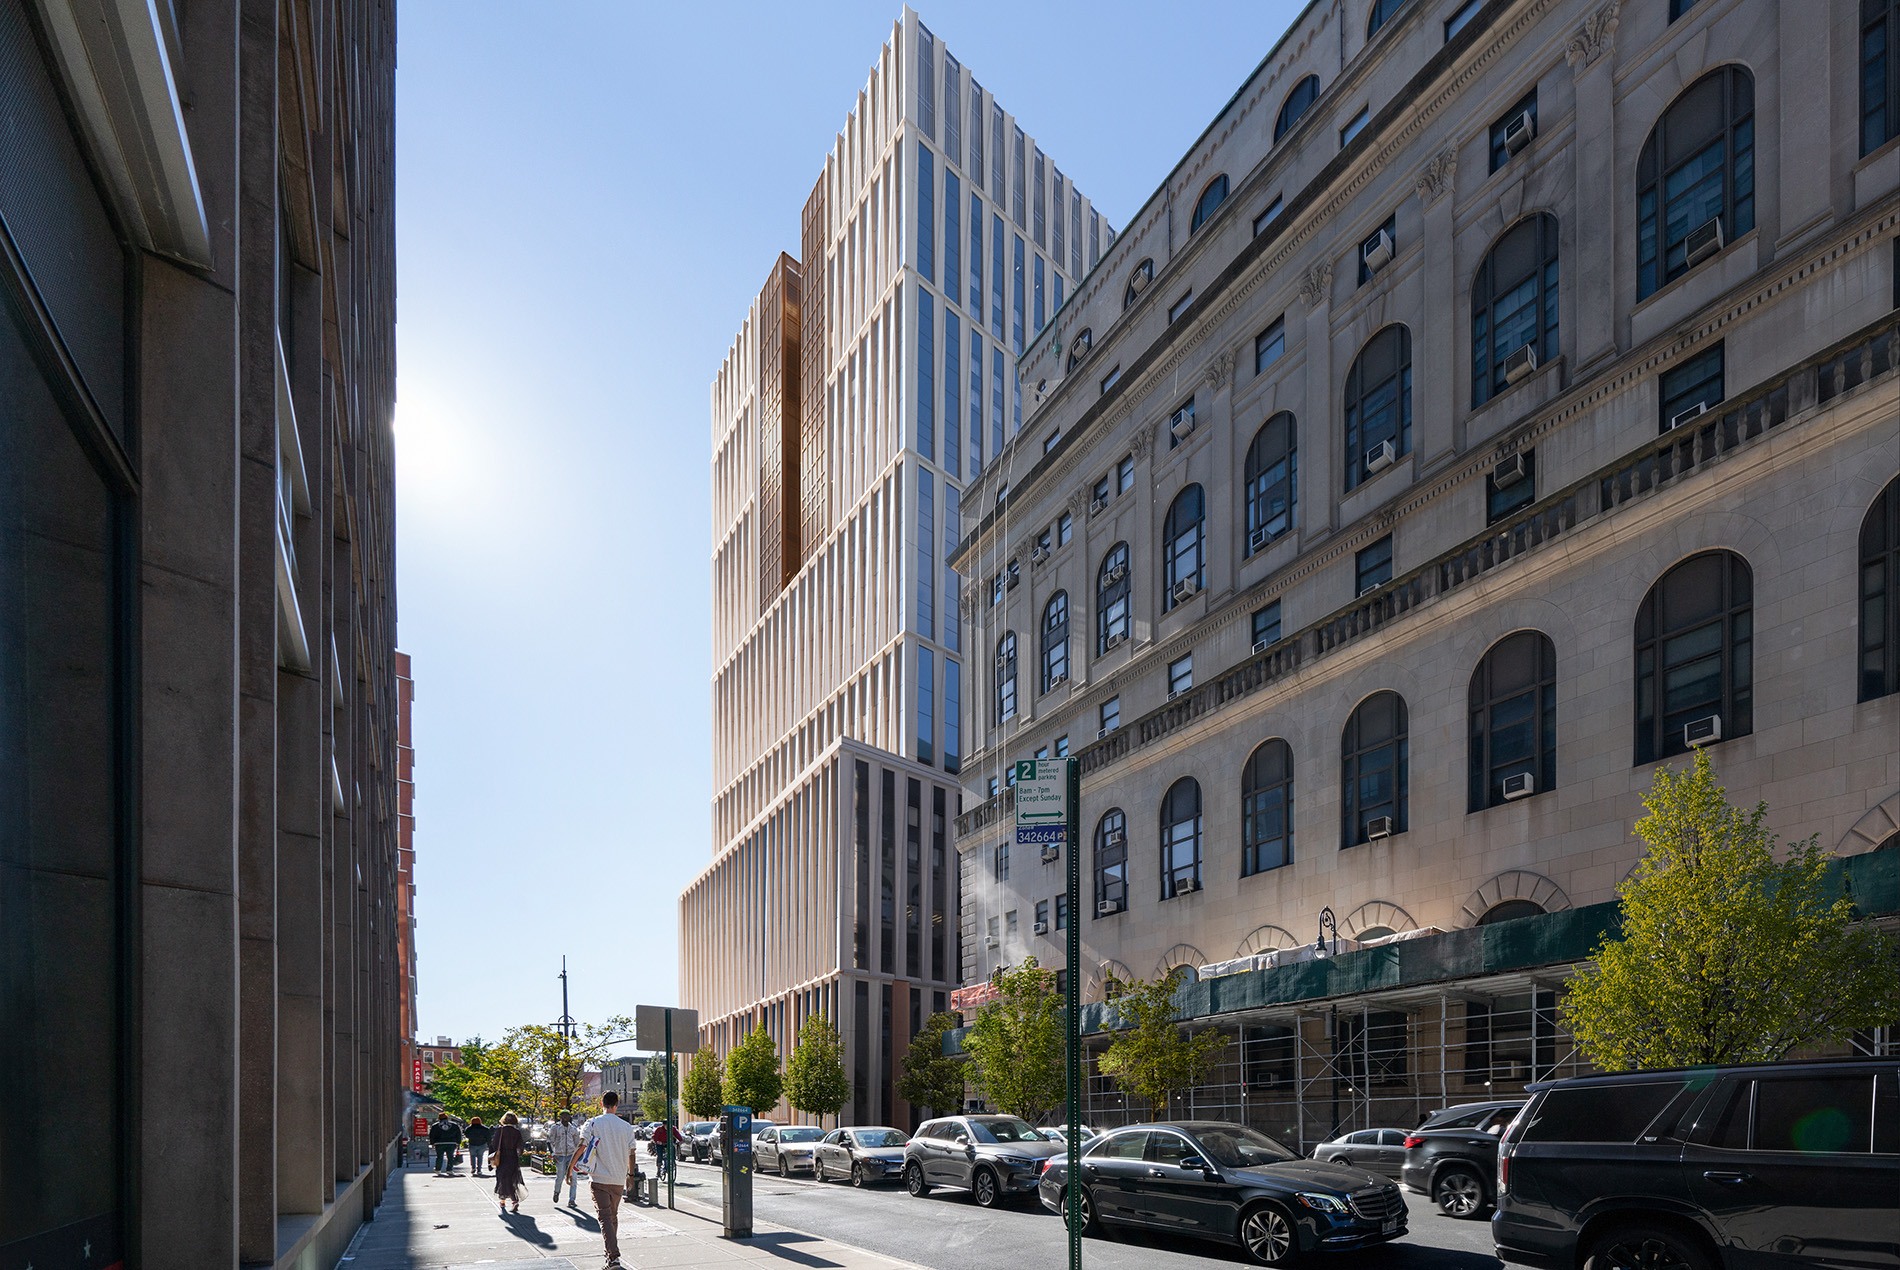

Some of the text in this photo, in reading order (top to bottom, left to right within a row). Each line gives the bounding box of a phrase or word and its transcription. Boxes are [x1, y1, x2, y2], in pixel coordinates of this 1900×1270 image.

[1021, 762, 1031, 779] 2
[1019, 795, 1039, 803] Except
[1018, 831, 1056, 843] 342664
[739, 1116, 748, 1128] P
